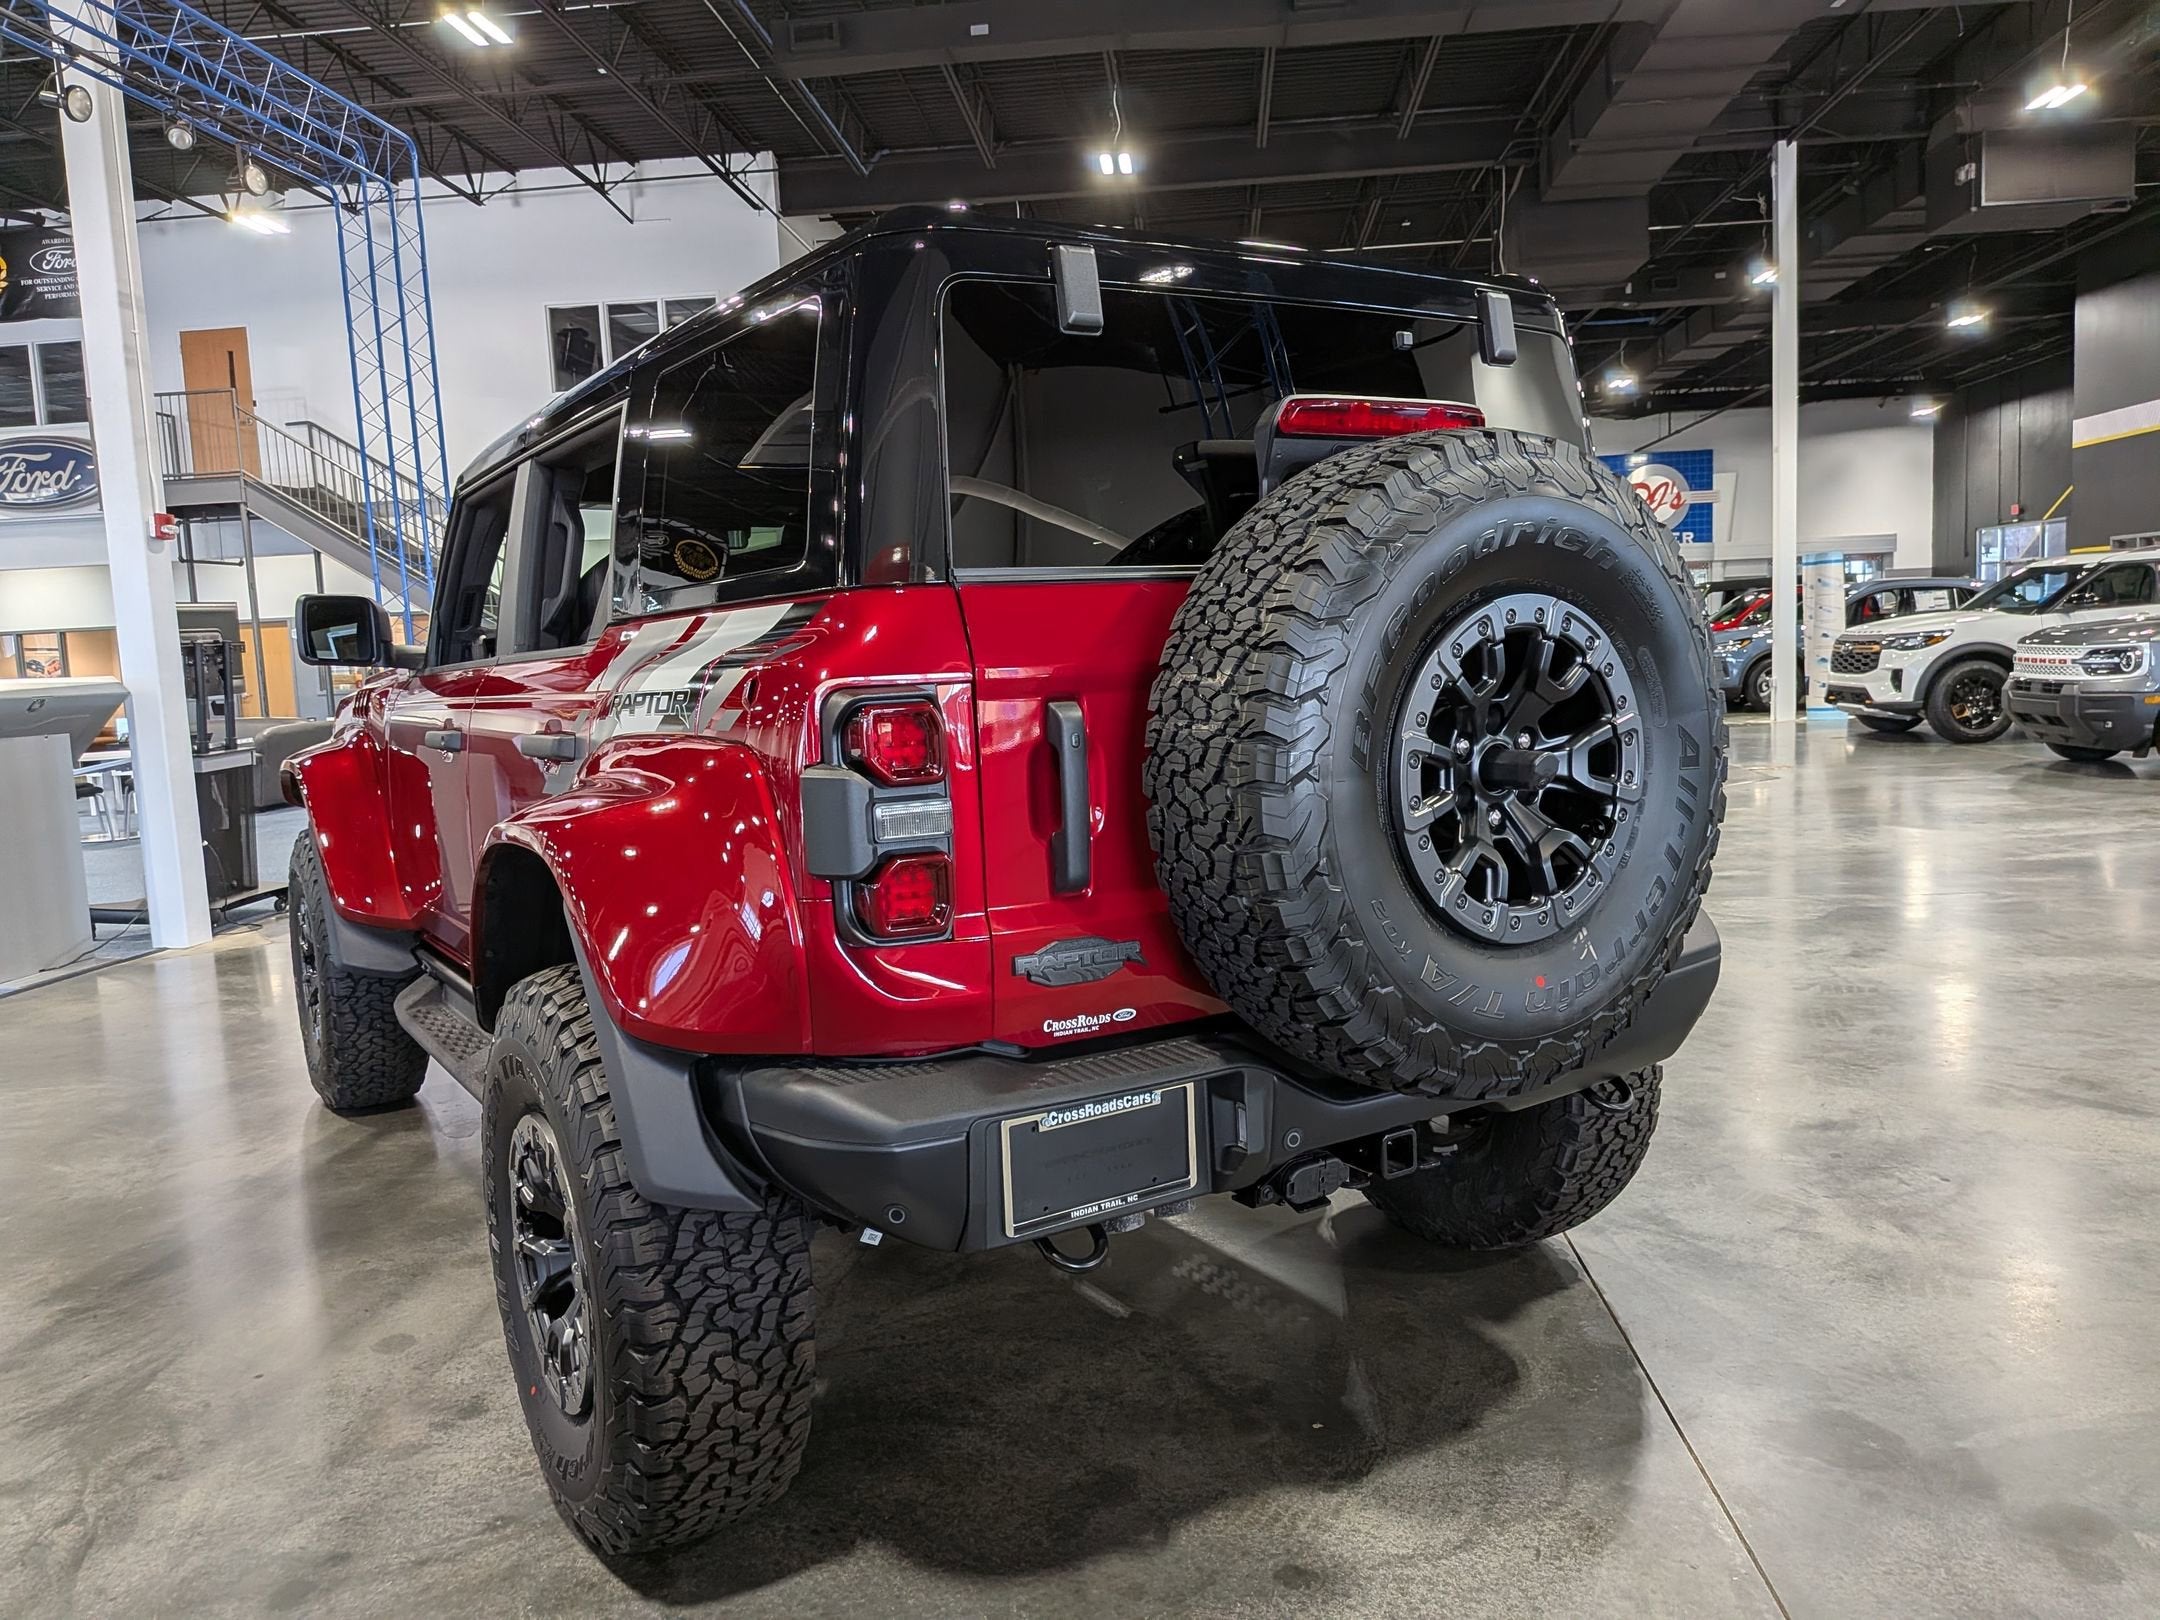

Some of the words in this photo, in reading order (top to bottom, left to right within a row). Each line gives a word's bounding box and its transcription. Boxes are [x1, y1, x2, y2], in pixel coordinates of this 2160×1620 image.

[34, 276, 75, 284] OUTSTANDING
[0, 453, 81, 493] Ford
[1351, 518, 1619, 772] BFGoodrich
[2016, 656, 2068, 665] BRONCO
[609, 689, 691, 729] RAPTOR
[1014, 940, 1149, 982] RAPTOR
[1053, 1029, 1073, 1038] INDIAN
[1070, 1205, 1099, 1219] INDIAN
[1100, 1198, 1126, 1211] TRAIL,
[1127, 1194, 1139, 1203] NC
